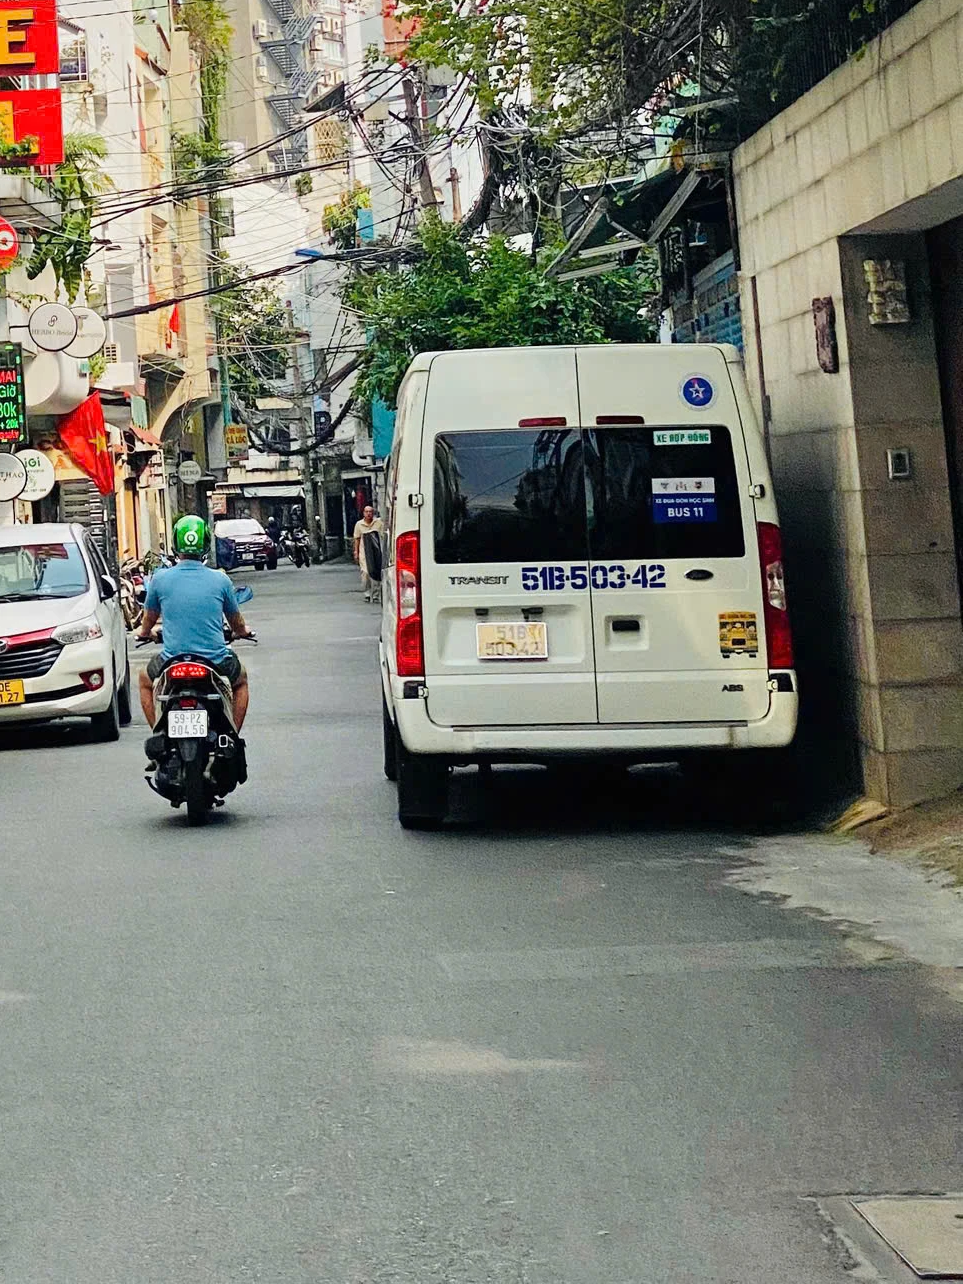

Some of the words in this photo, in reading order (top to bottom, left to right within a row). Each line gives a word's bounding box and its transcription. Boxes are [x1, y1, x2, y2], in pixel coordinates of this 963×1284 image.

[656, 434, 667, 443] XE
[668, 508, 690, 517] BUS
[693, 508, 704, 517] 11
[448, 575, 509, 585] TRANSIT
[497, 626, 526, 640] 51B
[722, 684, 744, 692] ABS
[172, 725, 205, 736] 904.56
